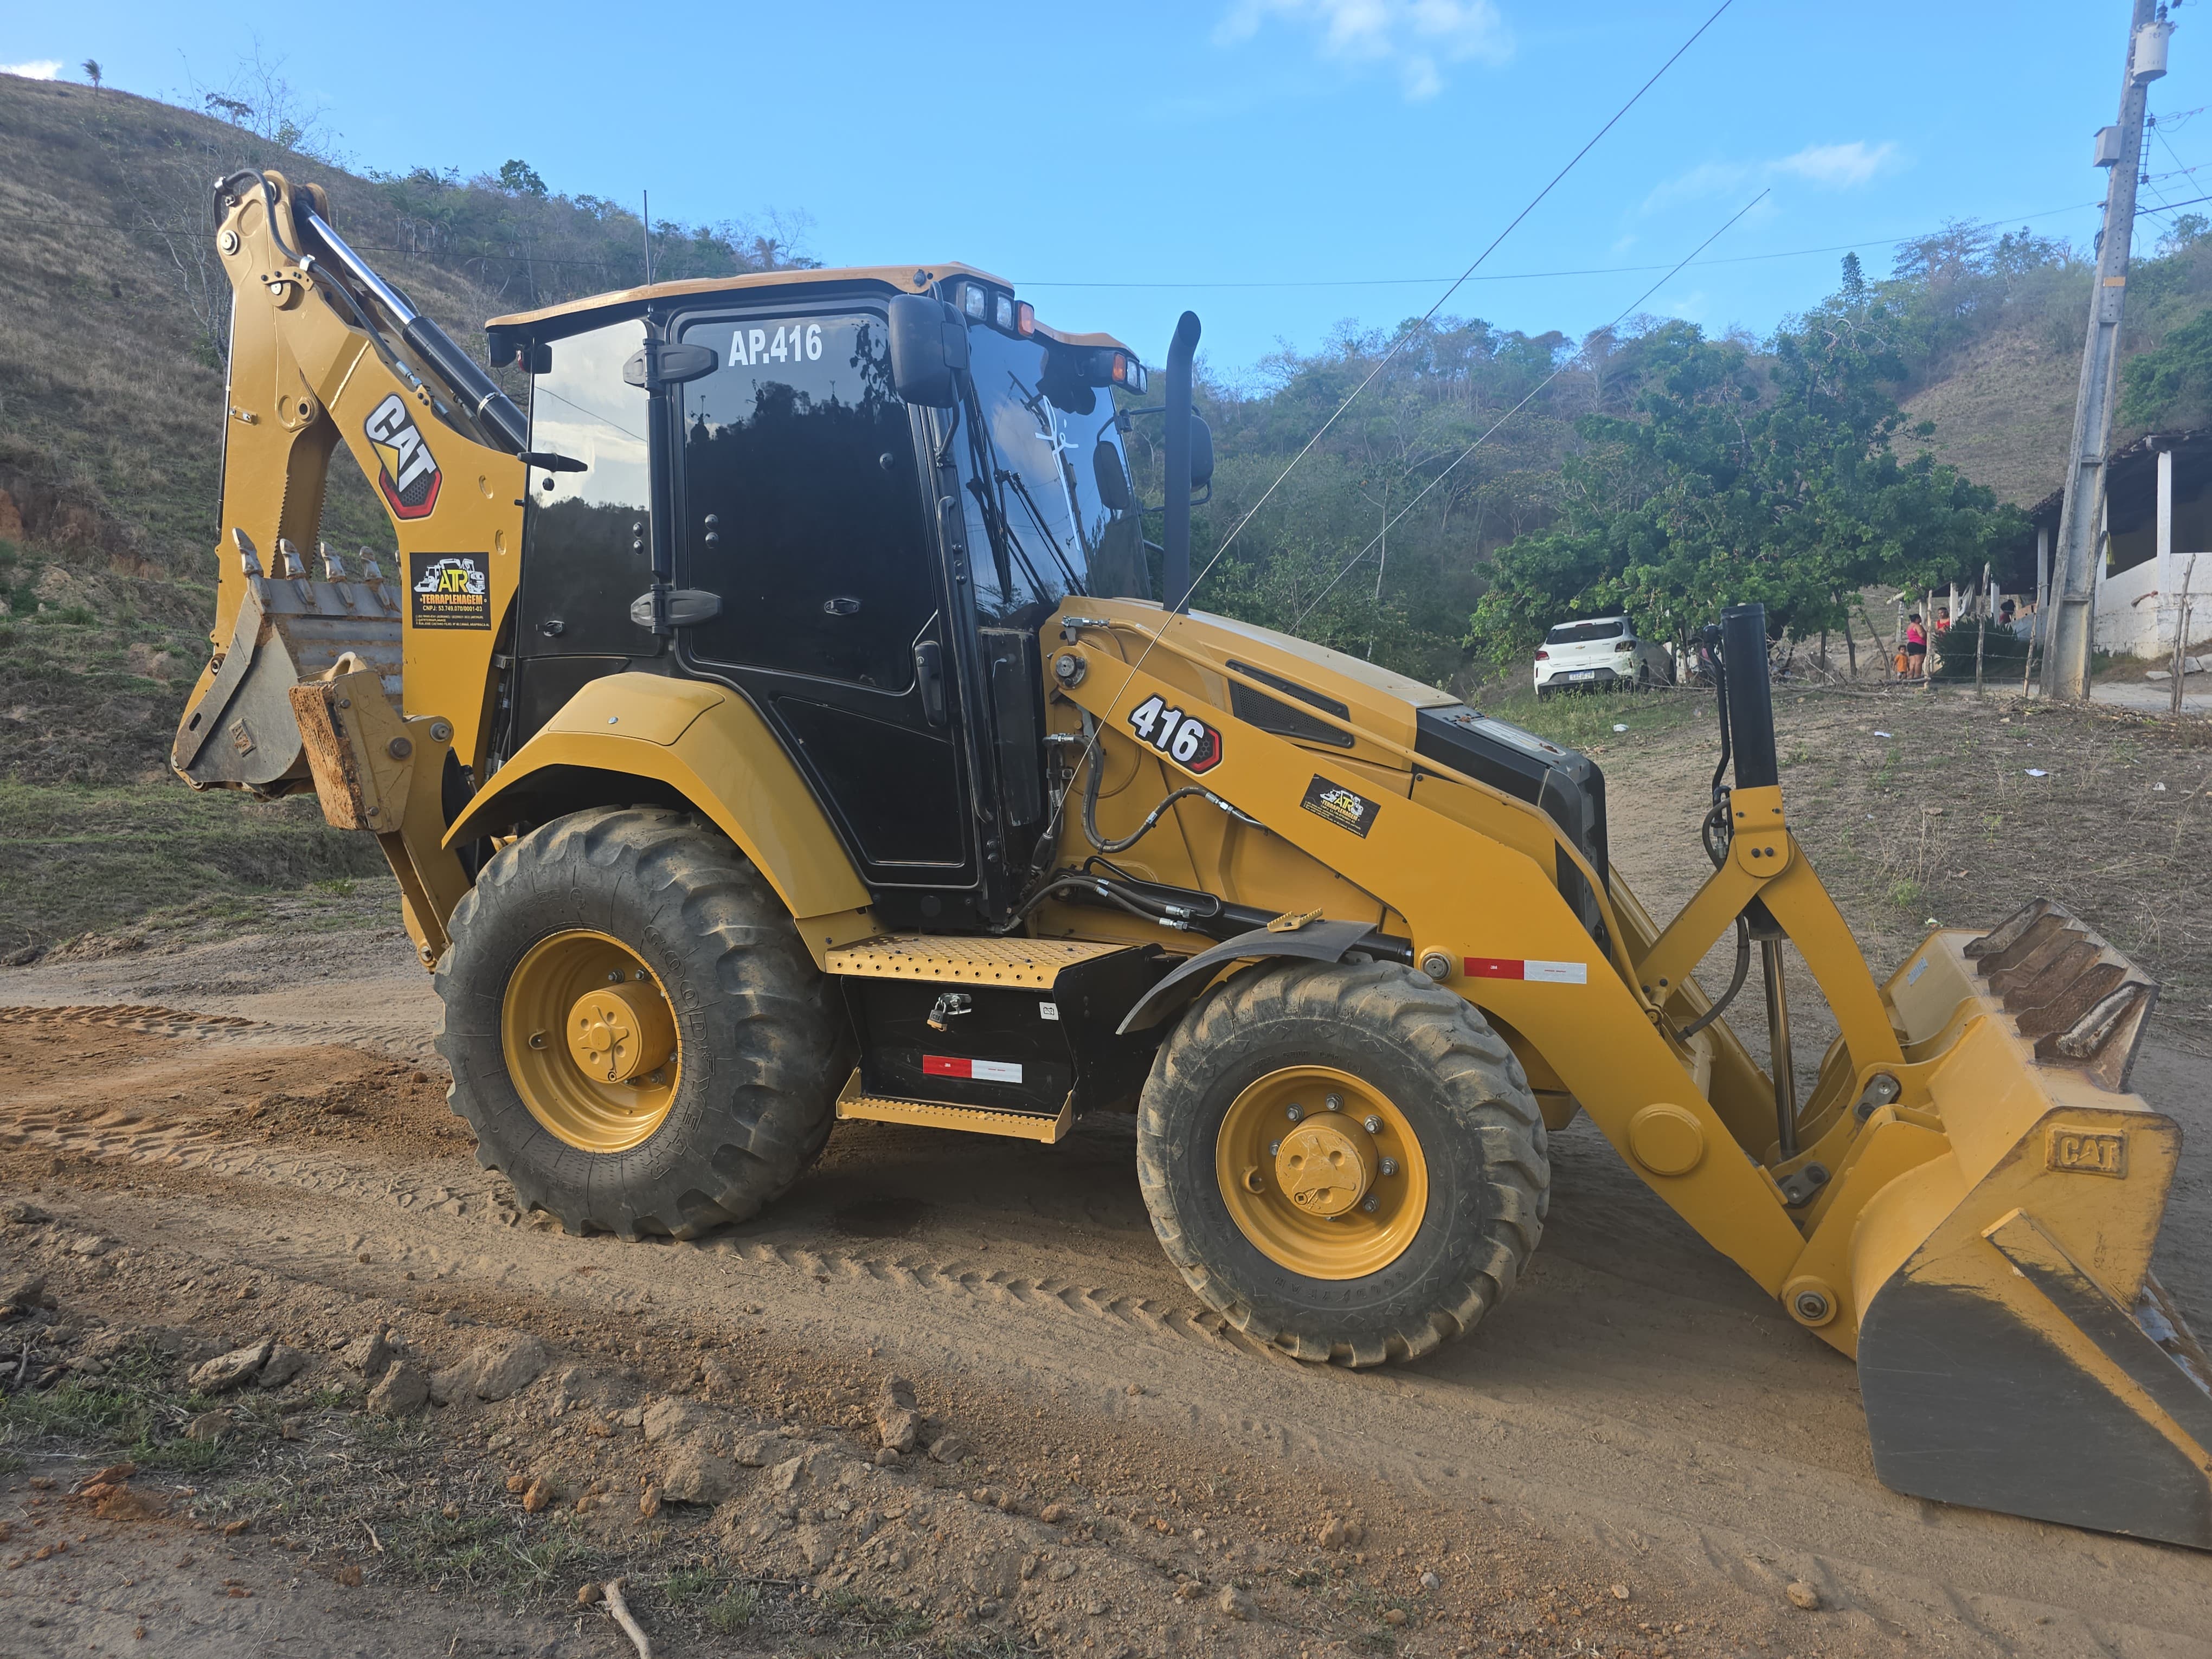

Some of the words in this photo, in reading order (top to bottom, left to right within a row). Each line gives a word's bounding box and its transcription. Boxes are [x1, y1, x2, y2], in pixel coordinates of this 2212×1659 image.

[728, 324, 822, 366] AP.416
[365, 395, 437, 493] CAT
[438, 569, 468, 593] ATR
[422, 594, 483, 605] TERRAPLENAGEM
[1130, 697, 1205, 762] 416
[1334, 794, 1354, 812] ATR
[2060, 1136, 2117, 1170] CAT
